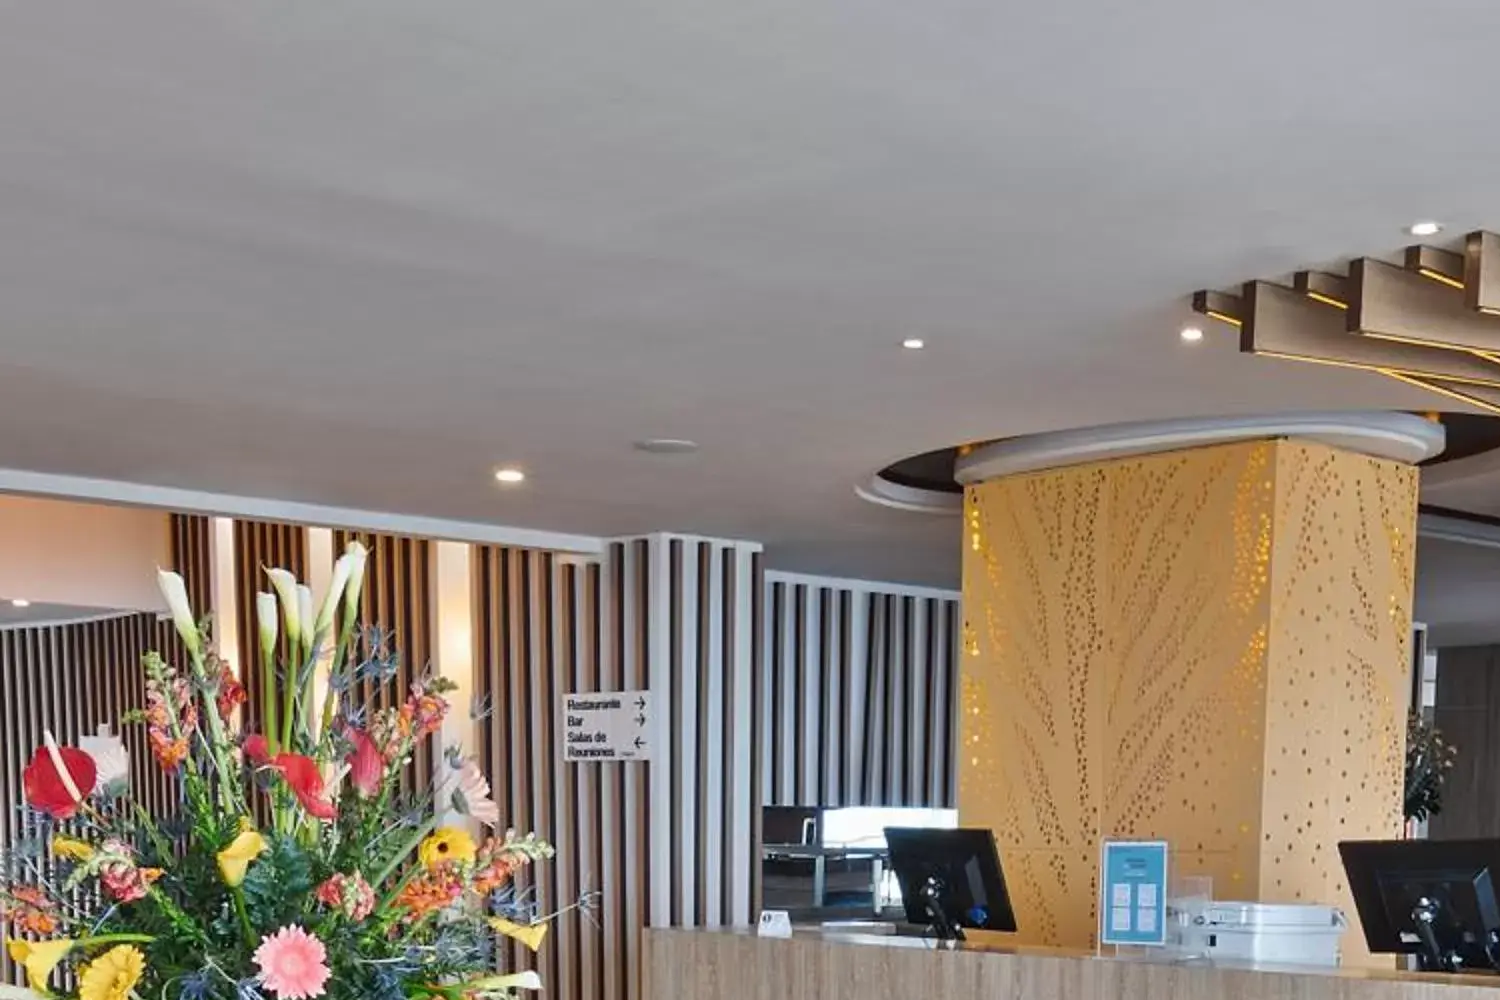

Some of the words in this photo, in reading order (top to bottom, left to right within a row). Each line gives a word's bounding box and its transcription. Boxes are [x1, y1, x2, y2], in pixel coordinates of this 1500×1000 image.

[567, 699, 621, 711] Restaurante
[567, 716, 584, 727] Bar
[567, 732, 593, 743] Salas
[594, 731, 607, 743] de
[567, 746, 615, 757] Reuniones
